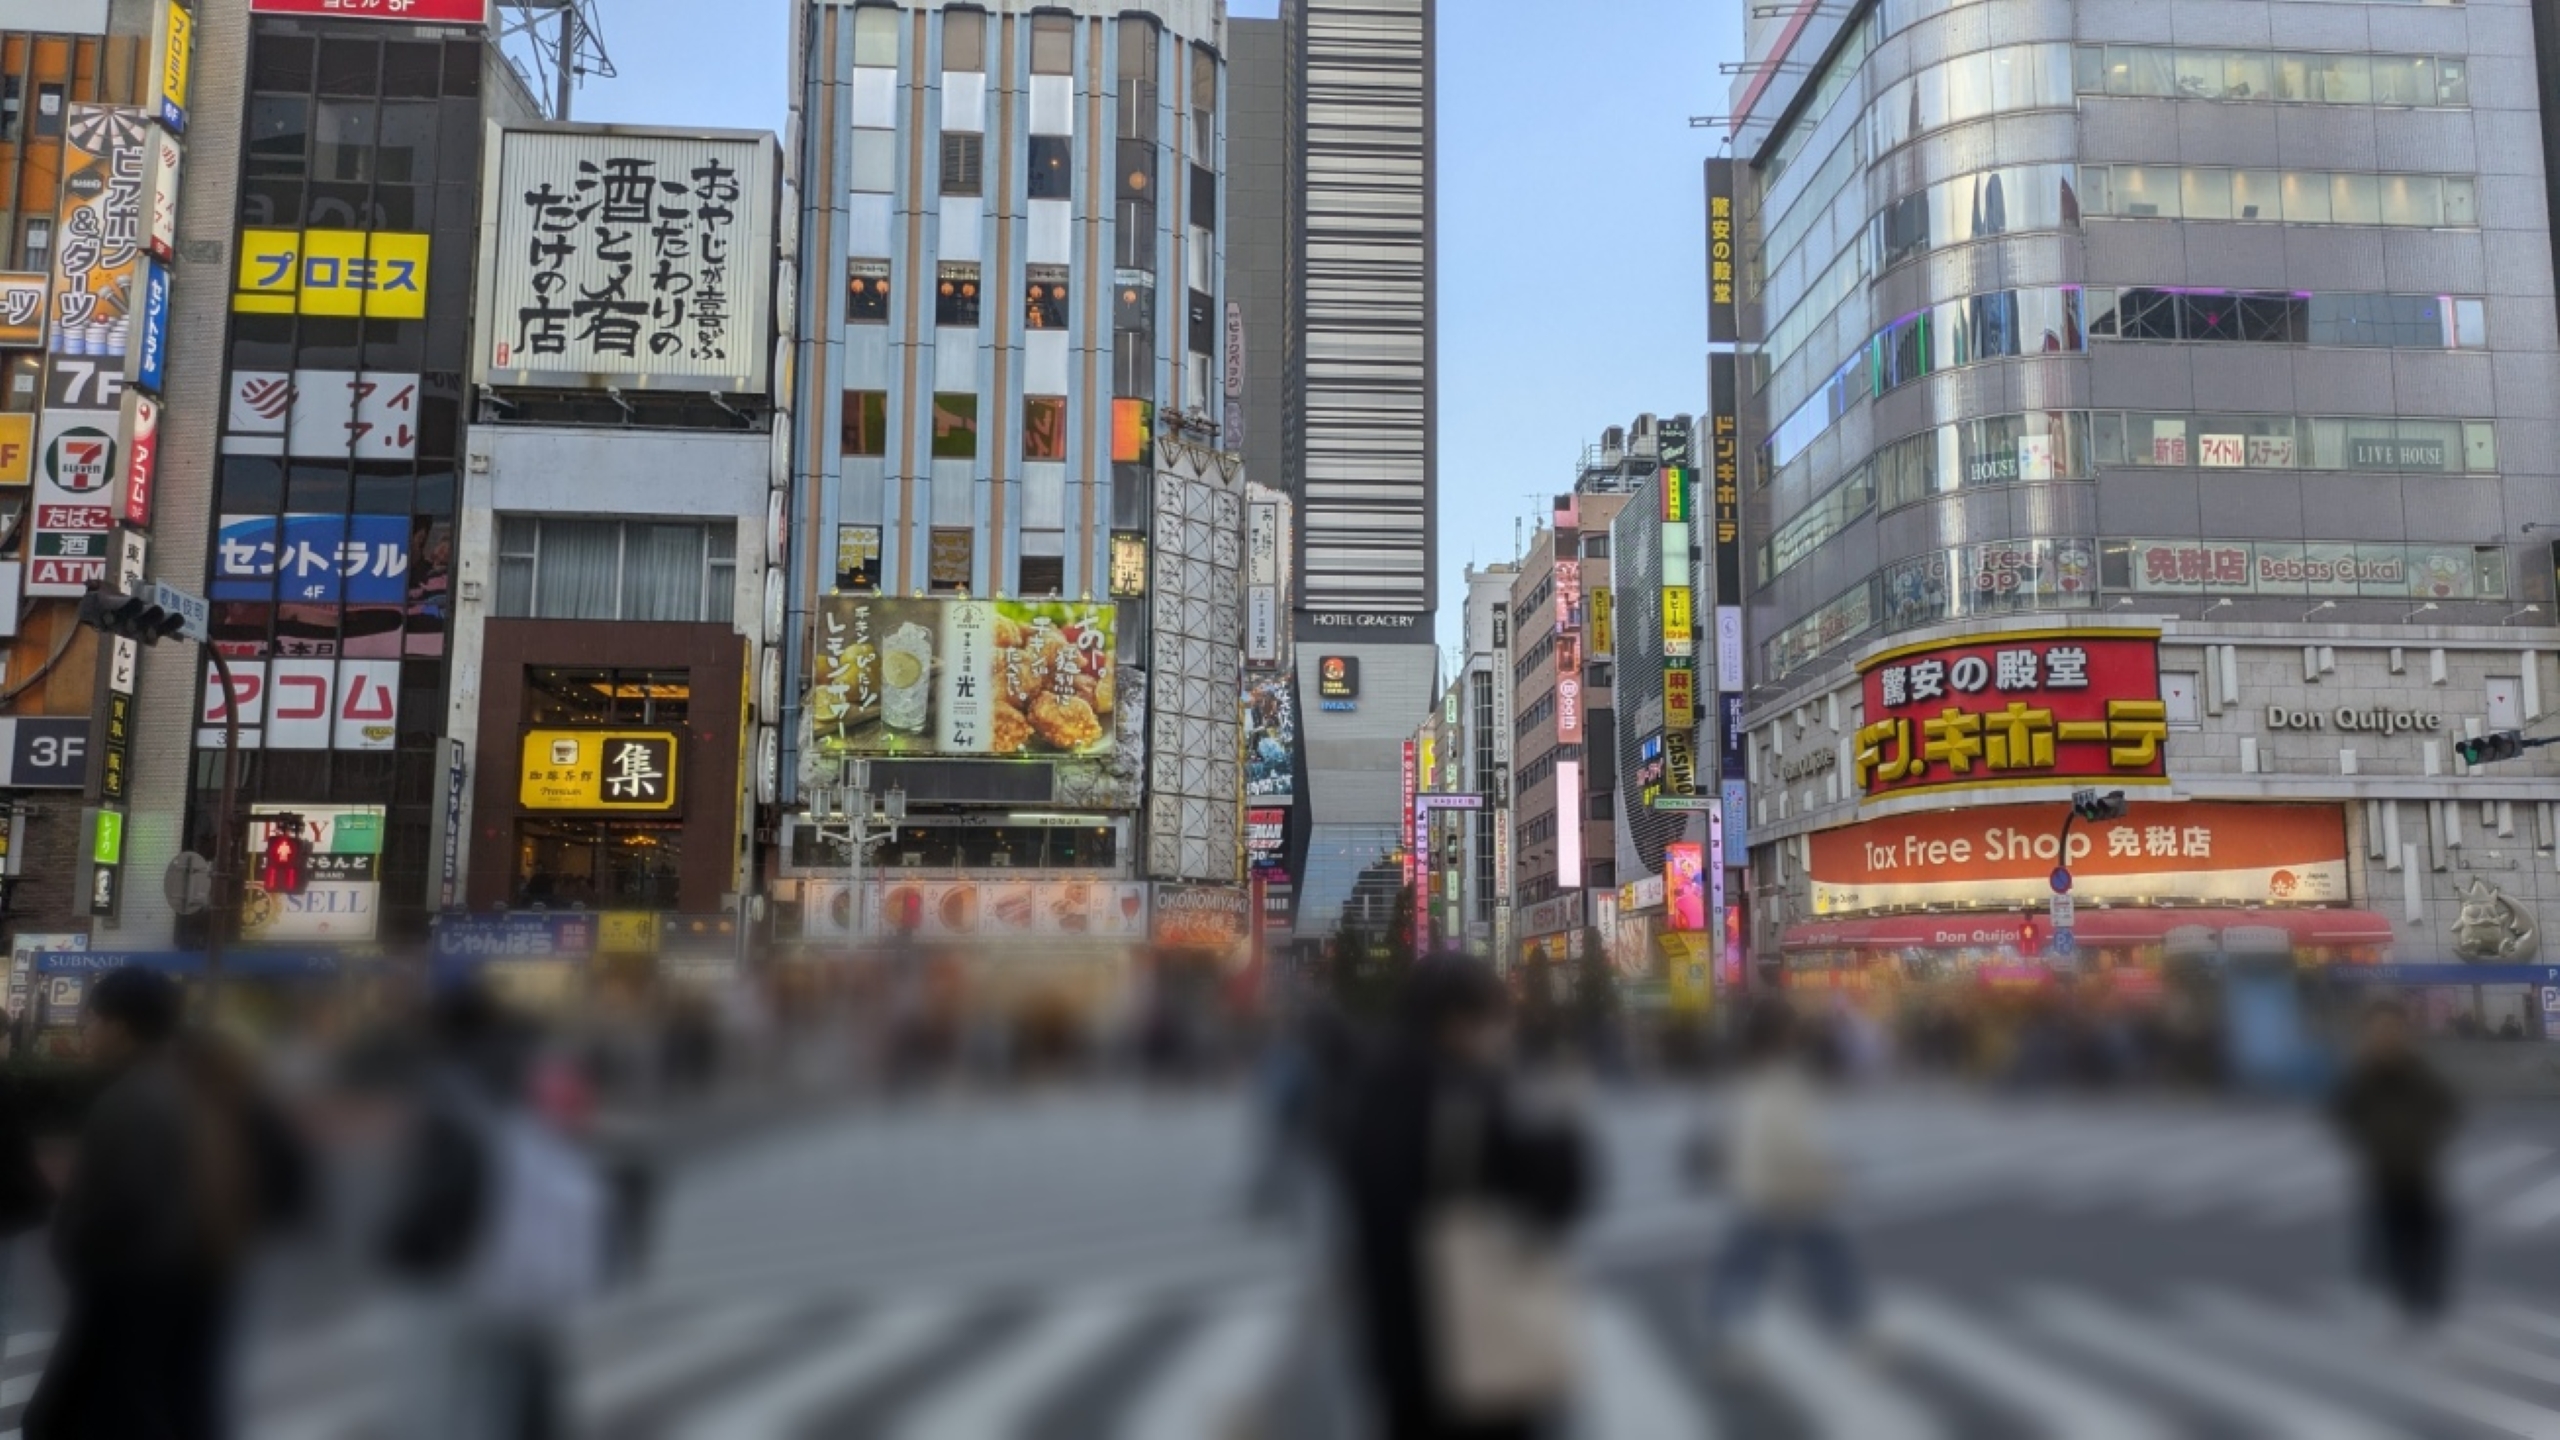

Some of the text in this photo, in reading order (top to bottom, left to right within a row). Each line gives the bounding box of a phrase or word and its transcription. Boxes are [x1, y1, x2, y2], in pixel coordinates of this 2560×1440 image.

[512, 183, 579, 354] だけの店
[649, 180, 694, 355] こだわりの
[1711, 197, 1732, 304] 驚安の殿堂
[255, 252, 418, 292] プロミス
[56, 361, 123, 403] 7F
[2154, 437, 2293, 465] 新宿 アイドル ステージ
[2358, 446, 2443, 465] LIVE HOUSE
[131, 444, 149, 504] アコム
[1971, 460, 2018, 480] HOUSE
[46, 508, 108, 528] たばこ
[59, 534, 90, 555] 酒
[219, 537, 408, 578] セントラル
[38, 562, 106, 582] ATM
[2145, 547, 2249, 584] 免税店
[2260, 559, 2403, 582] Bebas Cukai
[303, 584, 325, 598] 4F
[1313, 614, 1415, 627] HOTEL GRACERY
[1668, 672, 1690, 710] 麻雀
[1881, 646, 2089, 707] 驚安の殿堂
[206, 674, 395, 721] アコム
[2267, 706, 2443, 736] Don Quijote
[29, 736, 86, 767] 3F
[606, 742, 663, 798] 集
[1666, 732, 1694, 794] CASINO
[1865, 825, 2212, 872] Tax Free Shop 免税店
[1158, 893, 1247, 913] OKONOMIYAKI
[1935, 930, 1967, 943] Don
